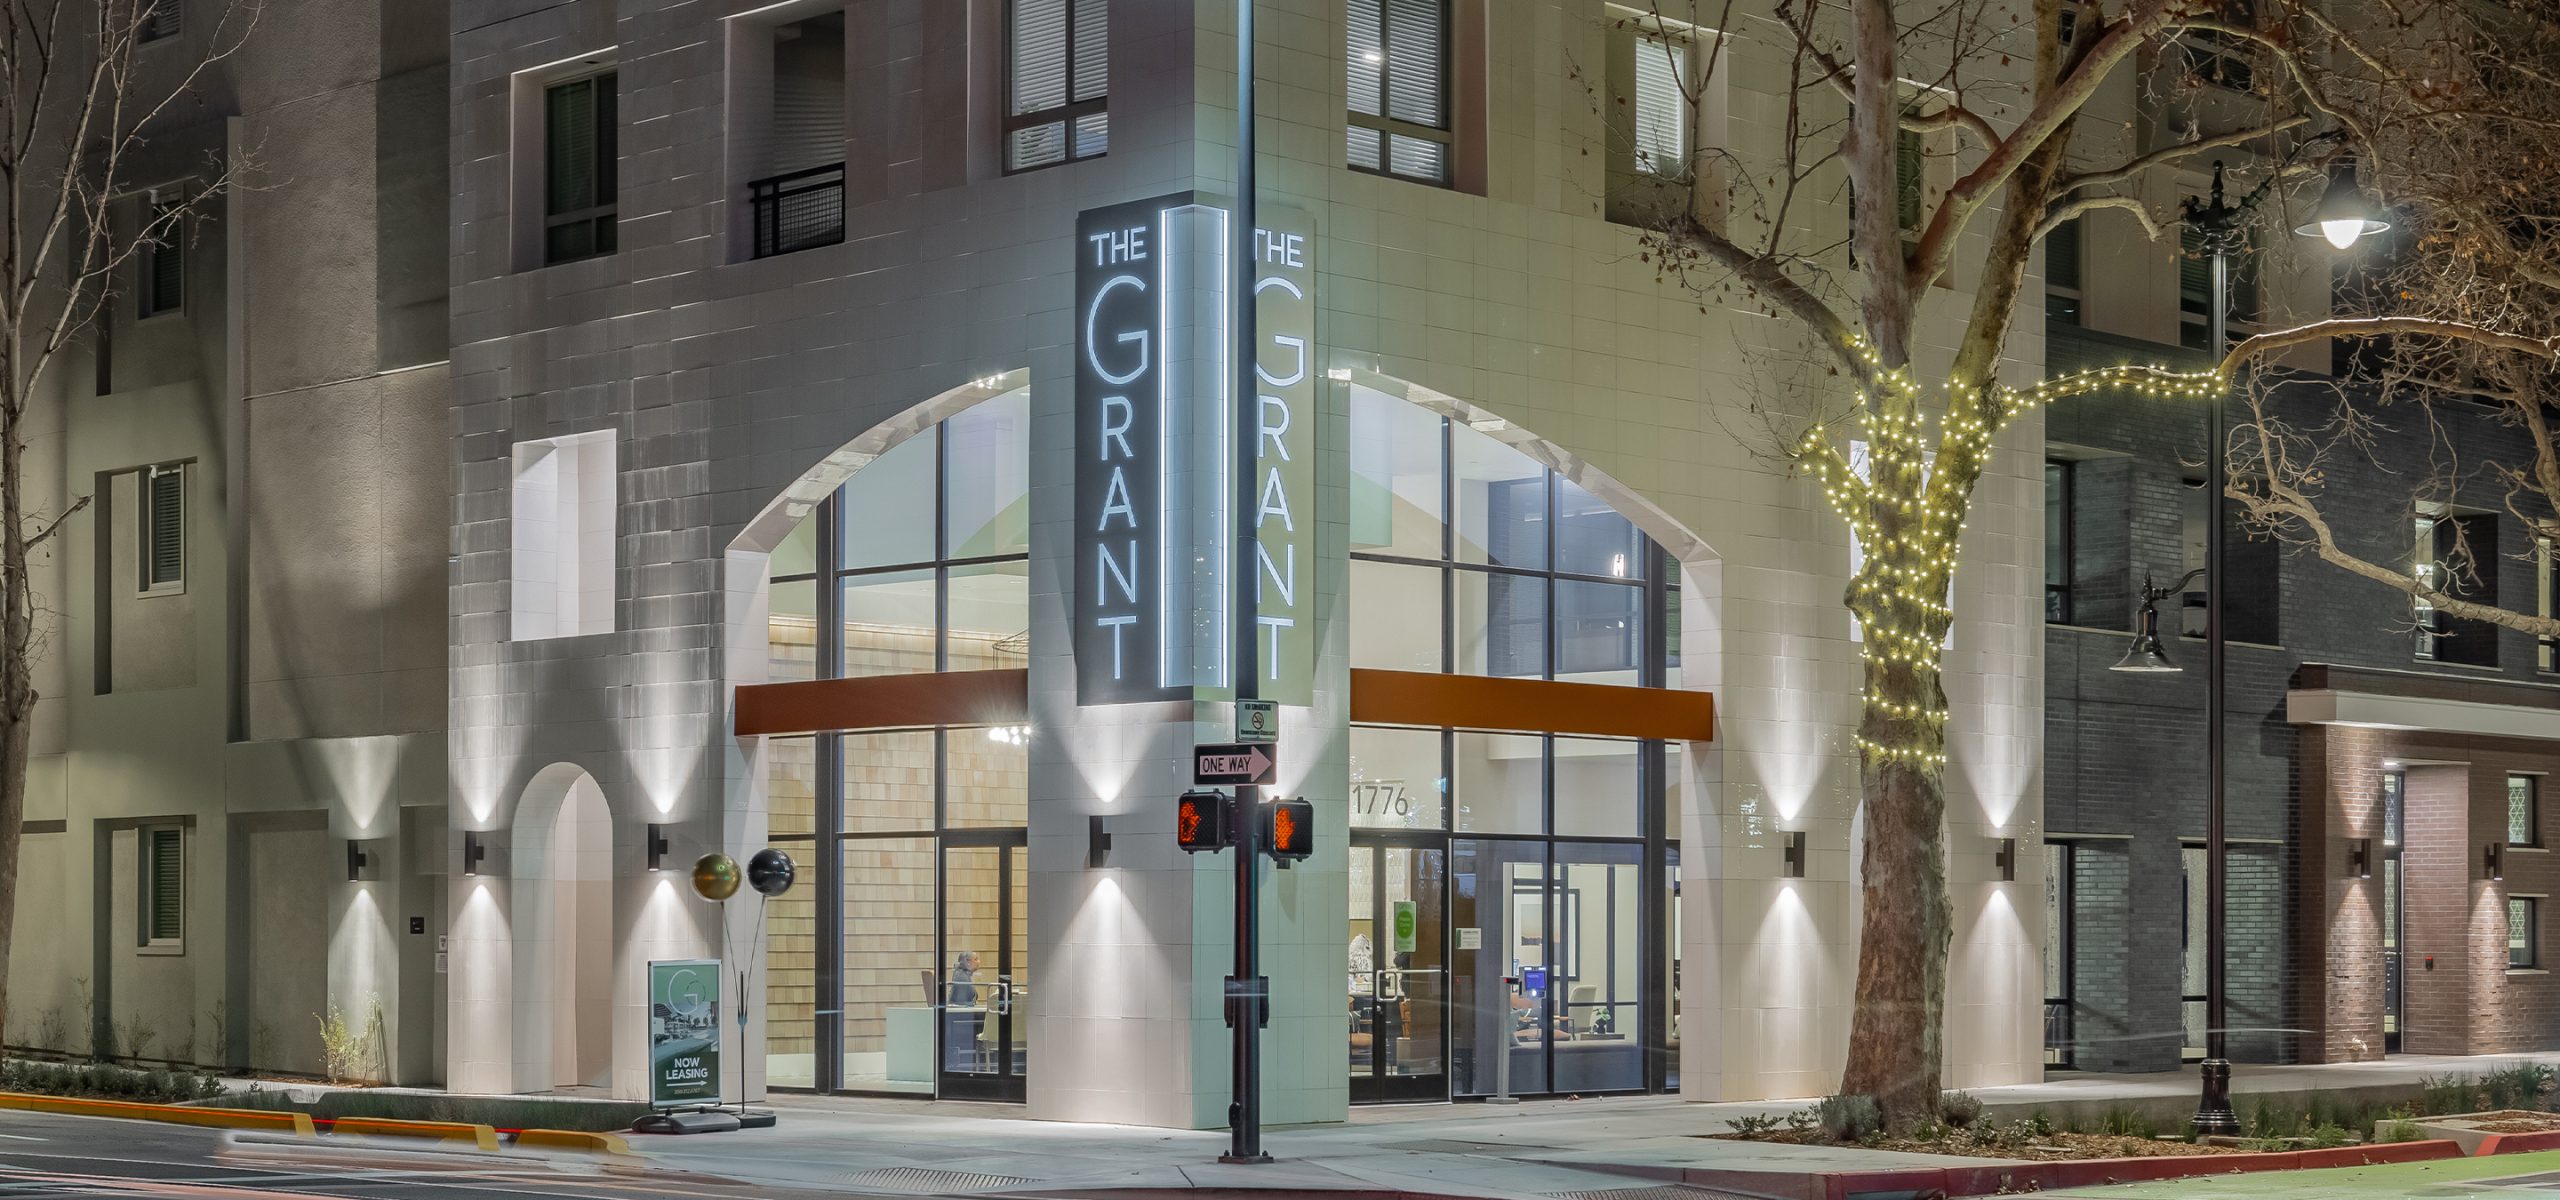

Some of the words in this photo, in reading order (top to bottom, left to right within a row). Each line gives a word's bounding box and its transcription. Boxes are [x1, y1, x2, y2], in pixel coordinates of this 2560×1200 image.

[1090, 226, 1147, 266] THE
[1254, 228, 1304, 268] THE
[1087, 275, 1148, 680] GRANT
[1255, 276, 1304, 680] GRANT
[1203, 758, 1224, 773] ONE
[1228, 756, 1251, 772] WAY
[1352, 785, 1409, 816] 1776
[665, 1068, 709, 1080] LEASING
[674, 1057, 700, 1069] NOW
